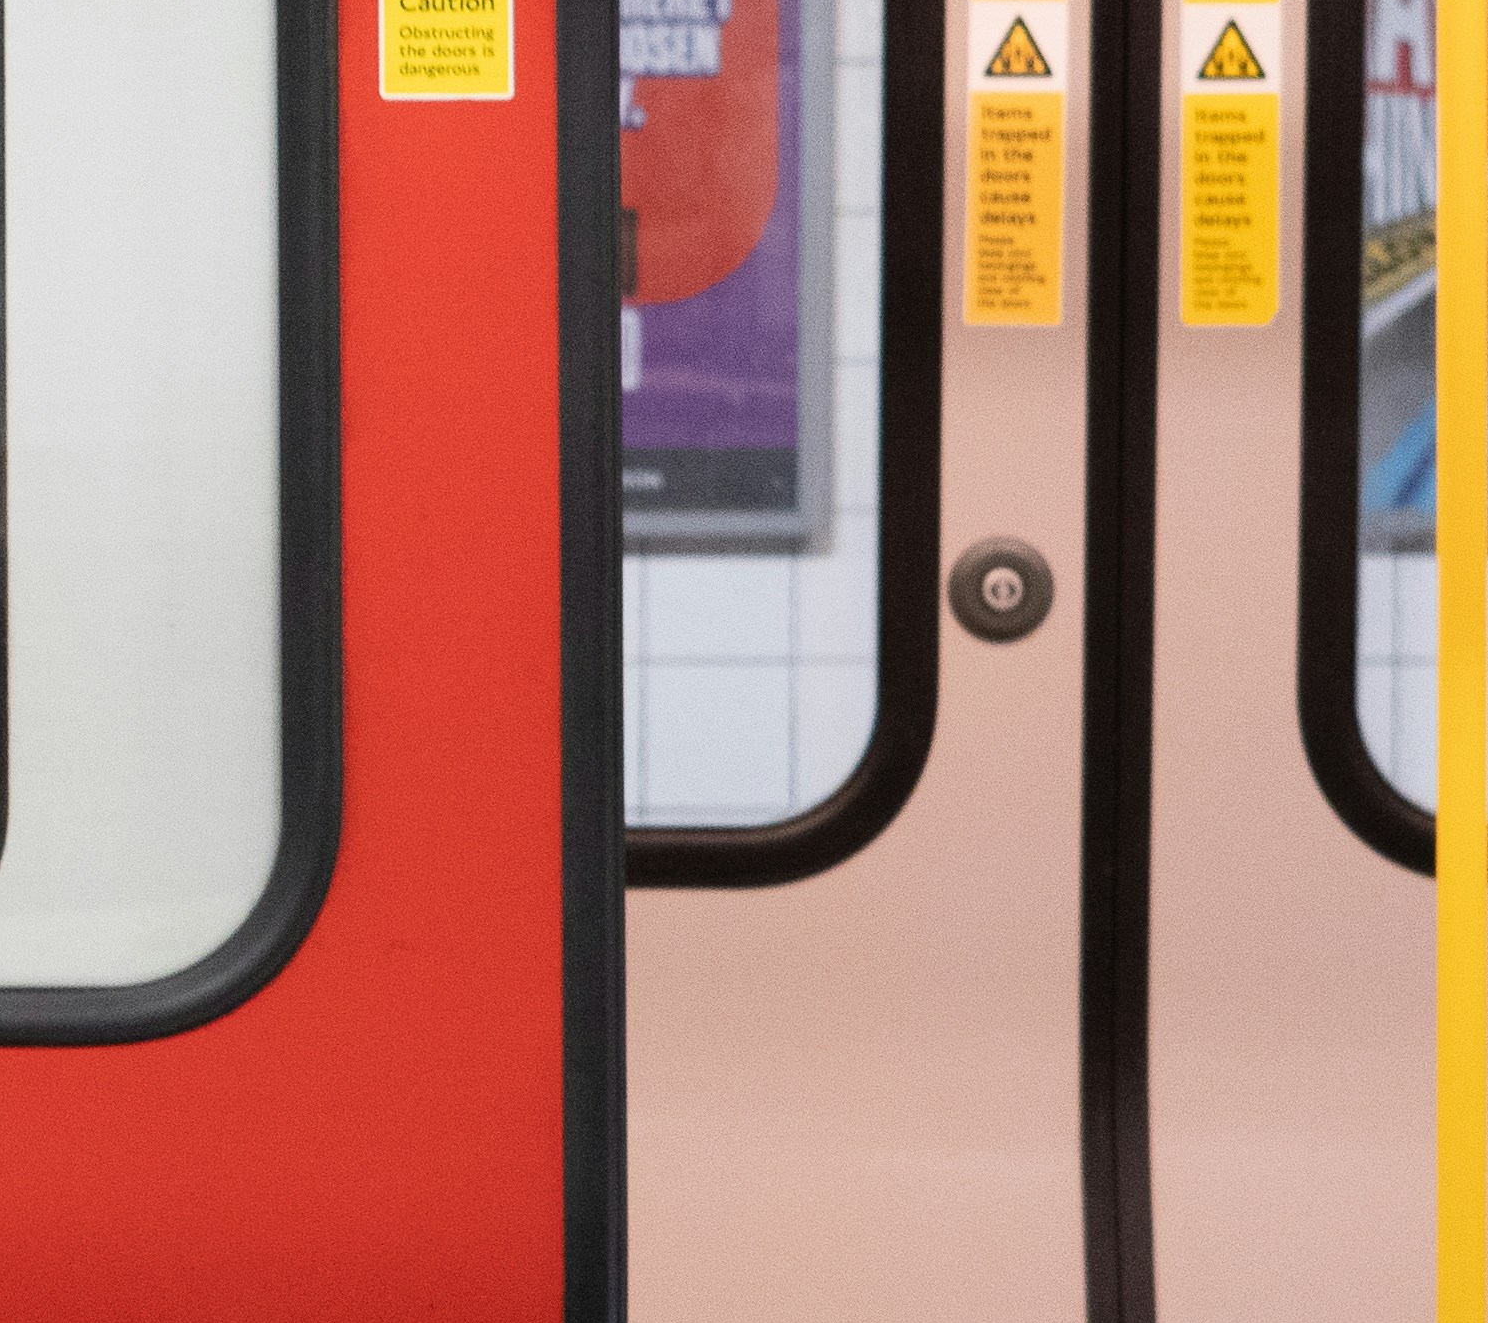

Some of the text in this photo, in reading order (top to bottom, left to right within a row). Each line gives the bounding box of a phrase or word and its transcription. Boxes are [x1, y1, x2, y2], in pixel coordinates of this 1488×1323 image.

[399, 26, 495, 42] Obstructing
[399, 45, 495, 57] the doors is
[399, 62, 480, 78] dangerous
